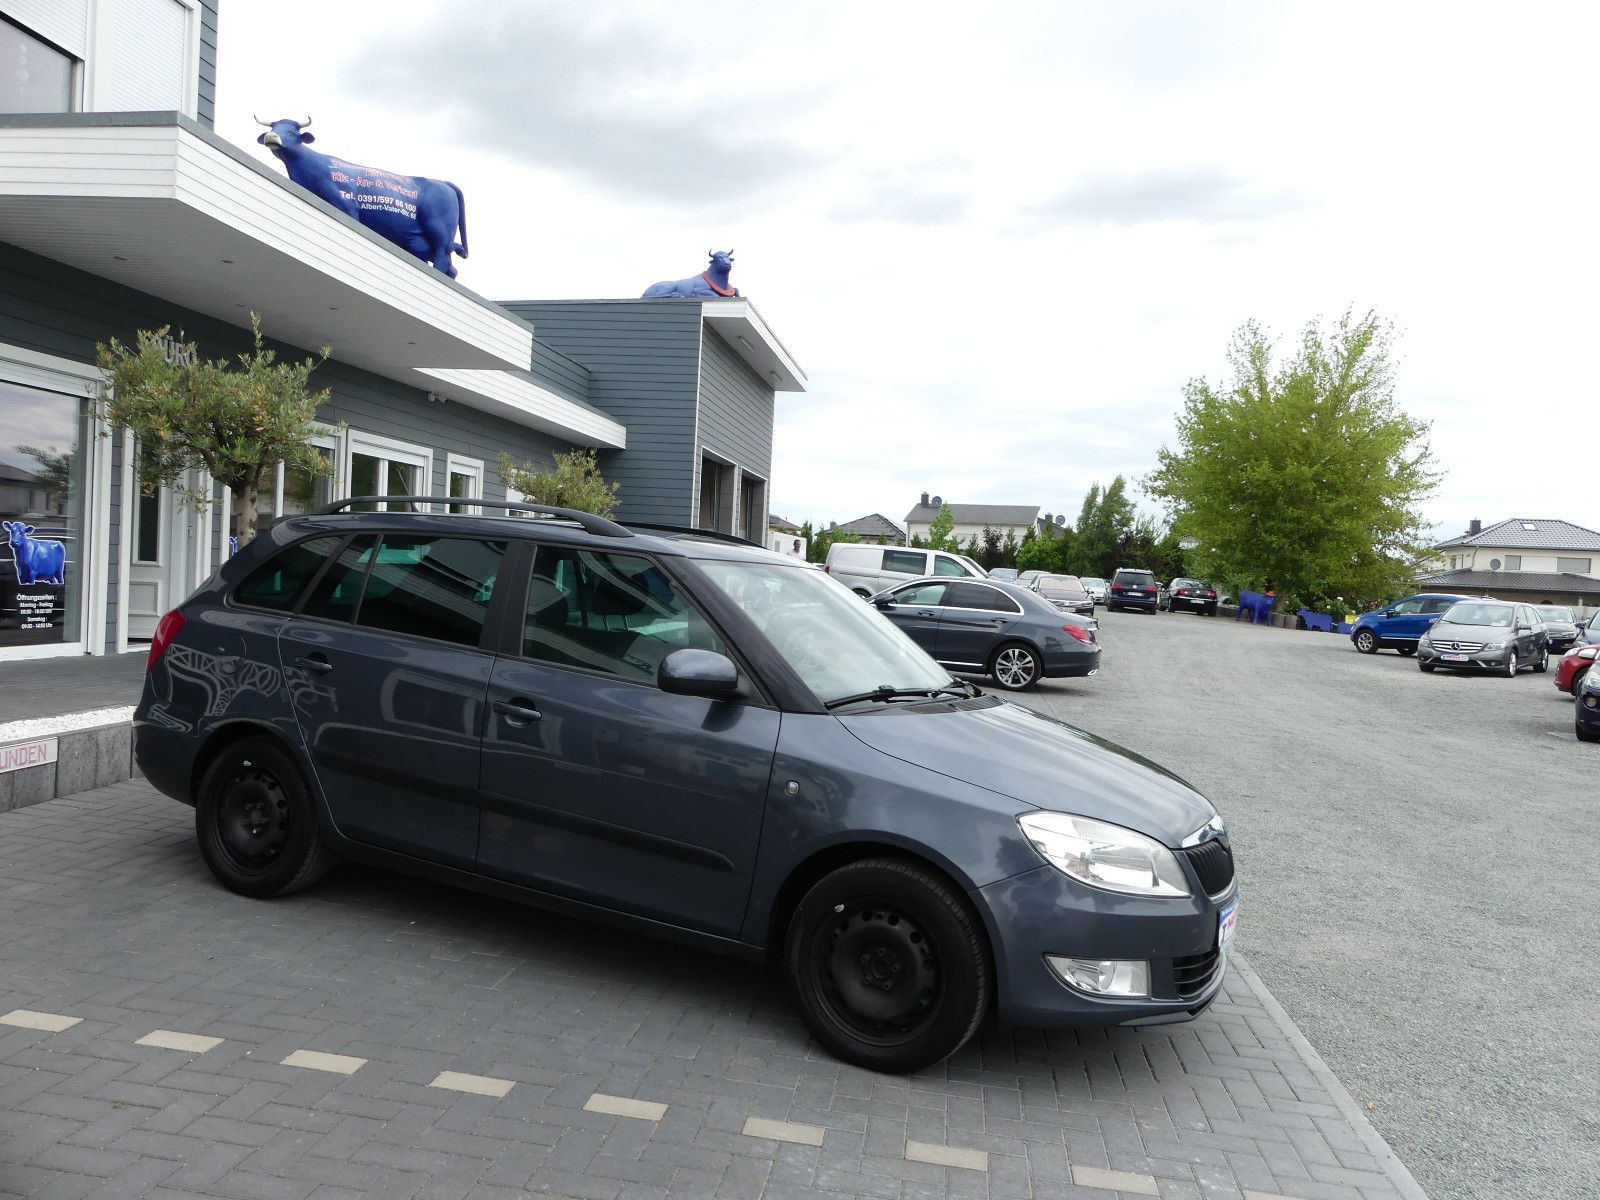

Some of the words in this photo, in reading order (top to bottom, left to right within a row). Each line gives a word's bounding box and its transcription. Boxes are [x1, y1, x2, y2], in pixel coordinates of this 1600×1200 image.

[339, 190, 355, 200] Tel.
[358, 194, 394, 204] 0391/597
[404, 203, 417, 213] 100
